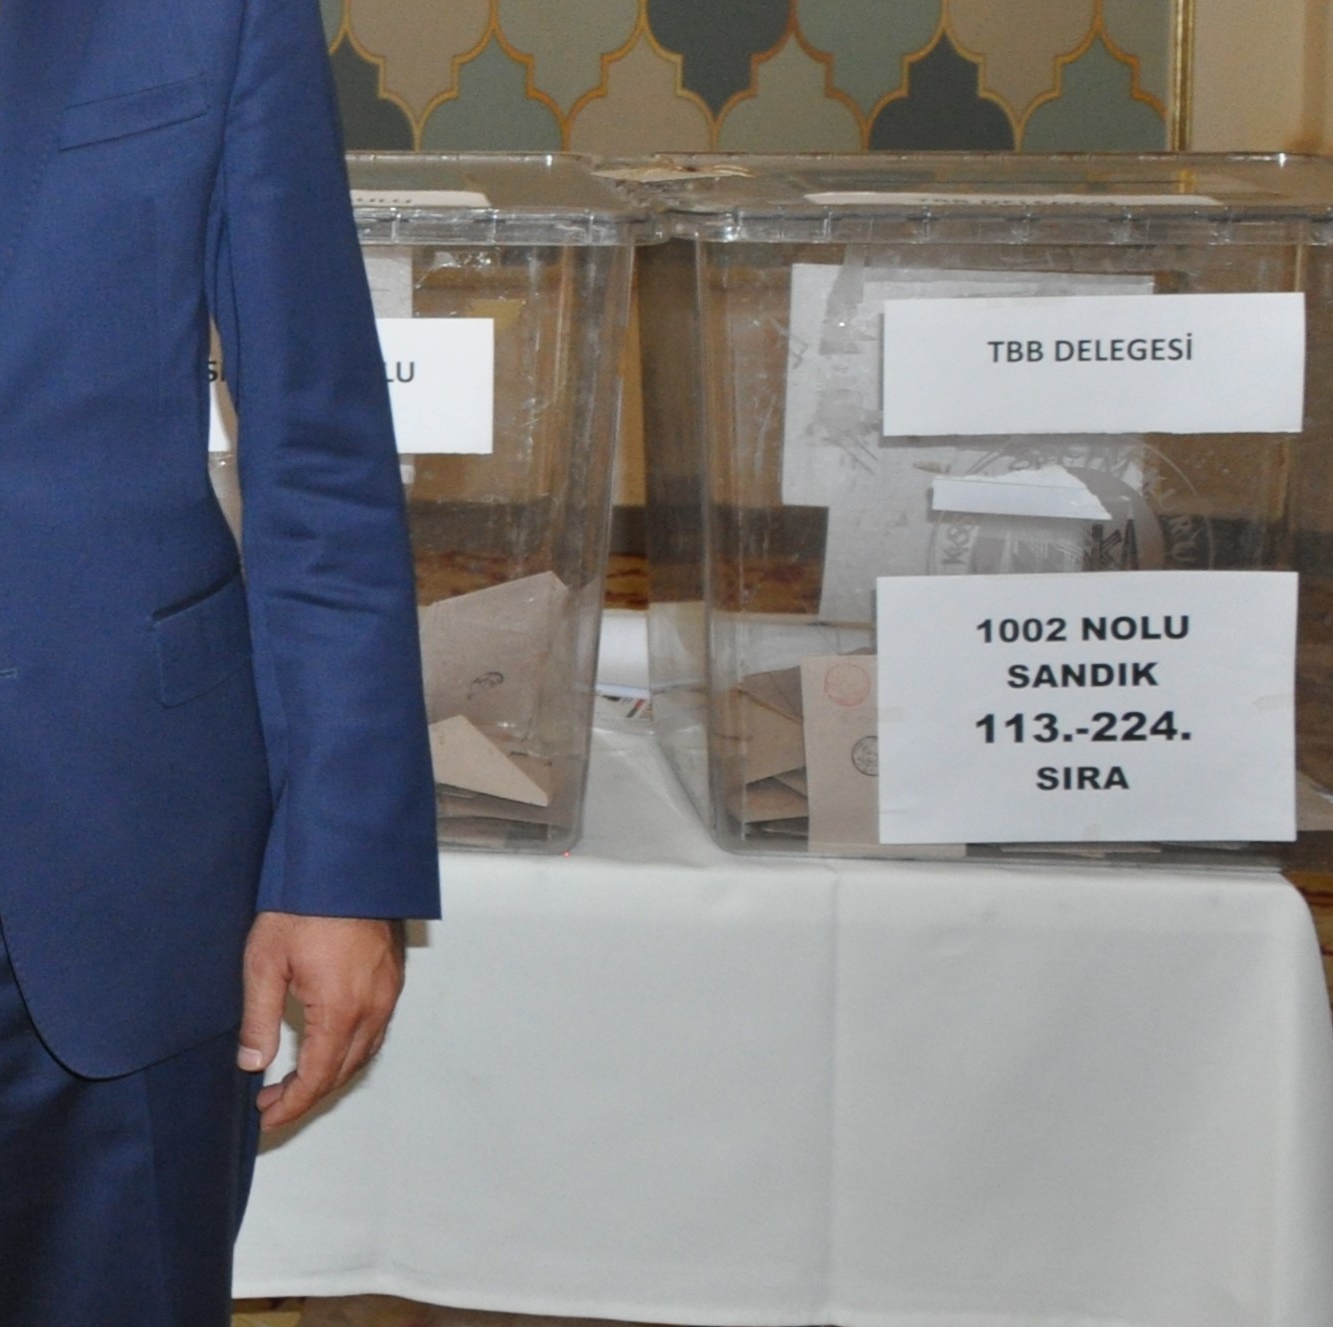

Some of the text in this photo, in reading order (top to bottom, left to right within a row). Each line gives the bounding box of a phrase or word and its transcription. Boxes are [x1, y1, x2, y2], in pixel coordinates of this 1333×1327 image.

[987, 332, 1192, 363] TBB DELEGESİ
[976, 614, 1190, 644] 1002 NOLU
[1007, 661, 1159, 689] SANDIK
[975, 710, 1192, 744] 113.-224.
[1036, 765, 1130, 791] SIRA
